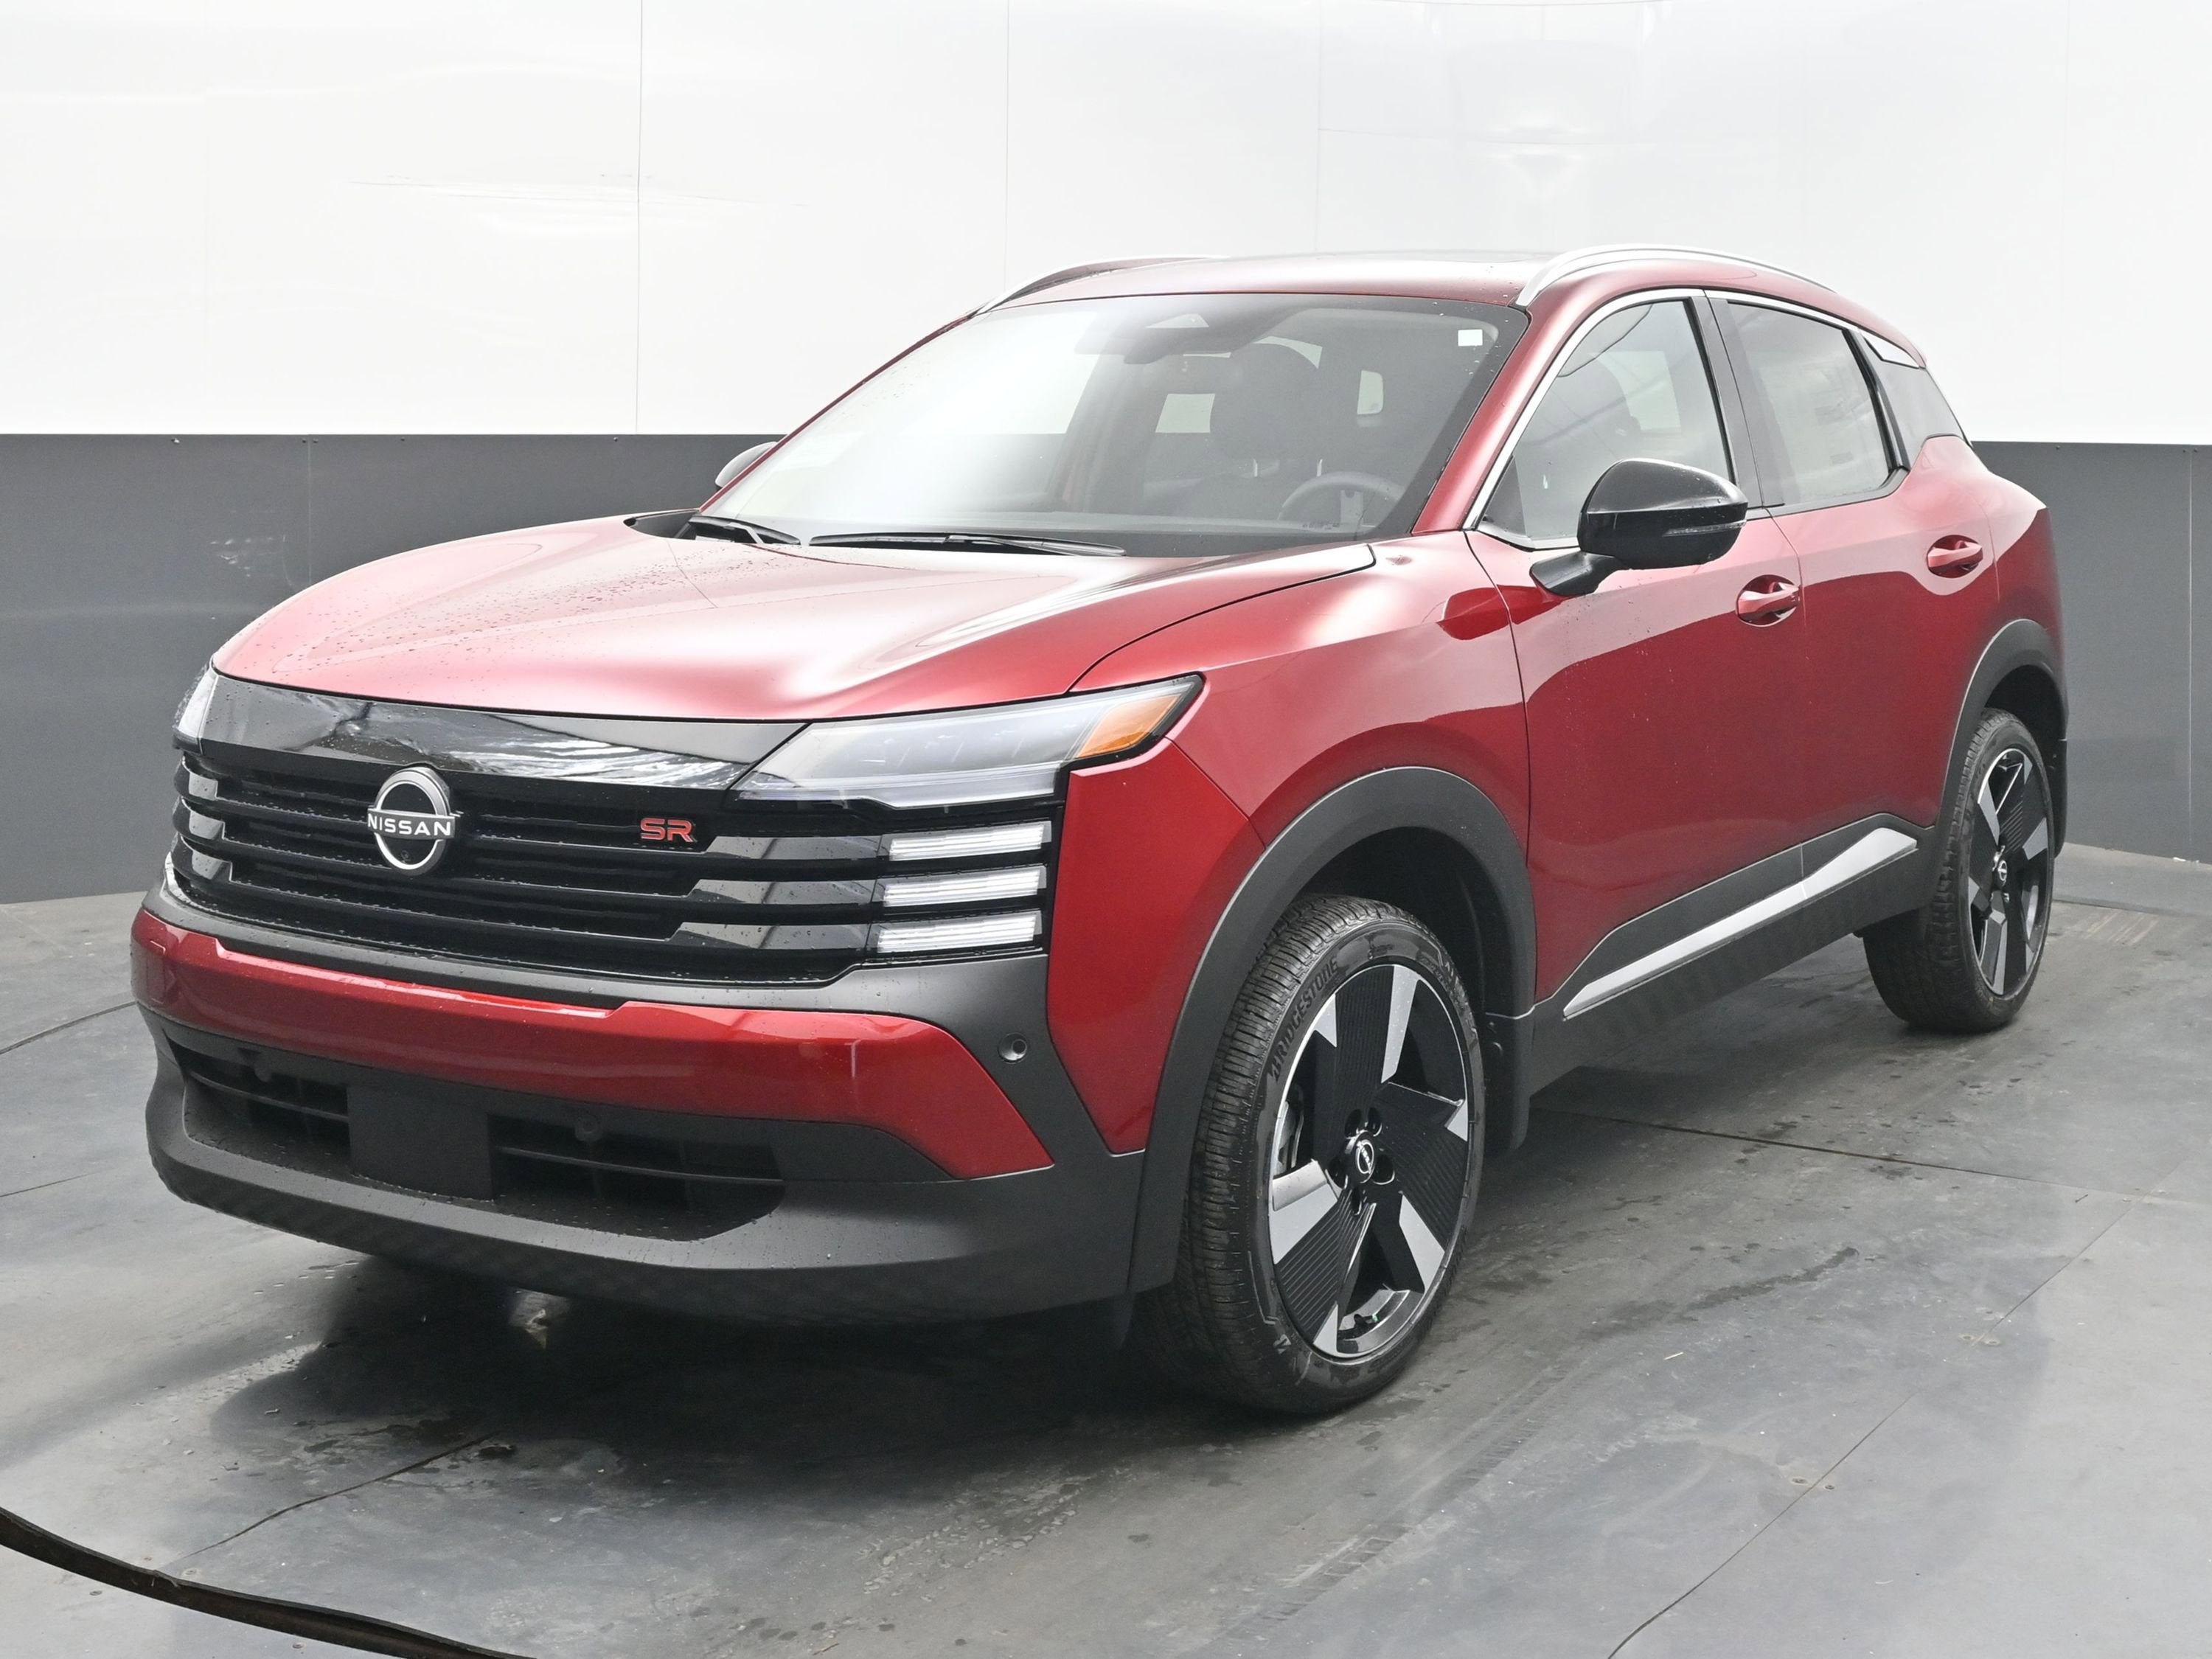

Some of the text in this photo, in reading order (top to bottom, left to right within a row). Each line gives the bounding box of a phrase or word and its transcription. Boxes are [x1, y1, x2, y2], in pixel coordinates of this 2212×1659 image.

[368, 813, 451, 836] NISSAN
[640, 818, 695, 843] SR
[1268, 958, 1338, 1082] BRIDGESTONE
